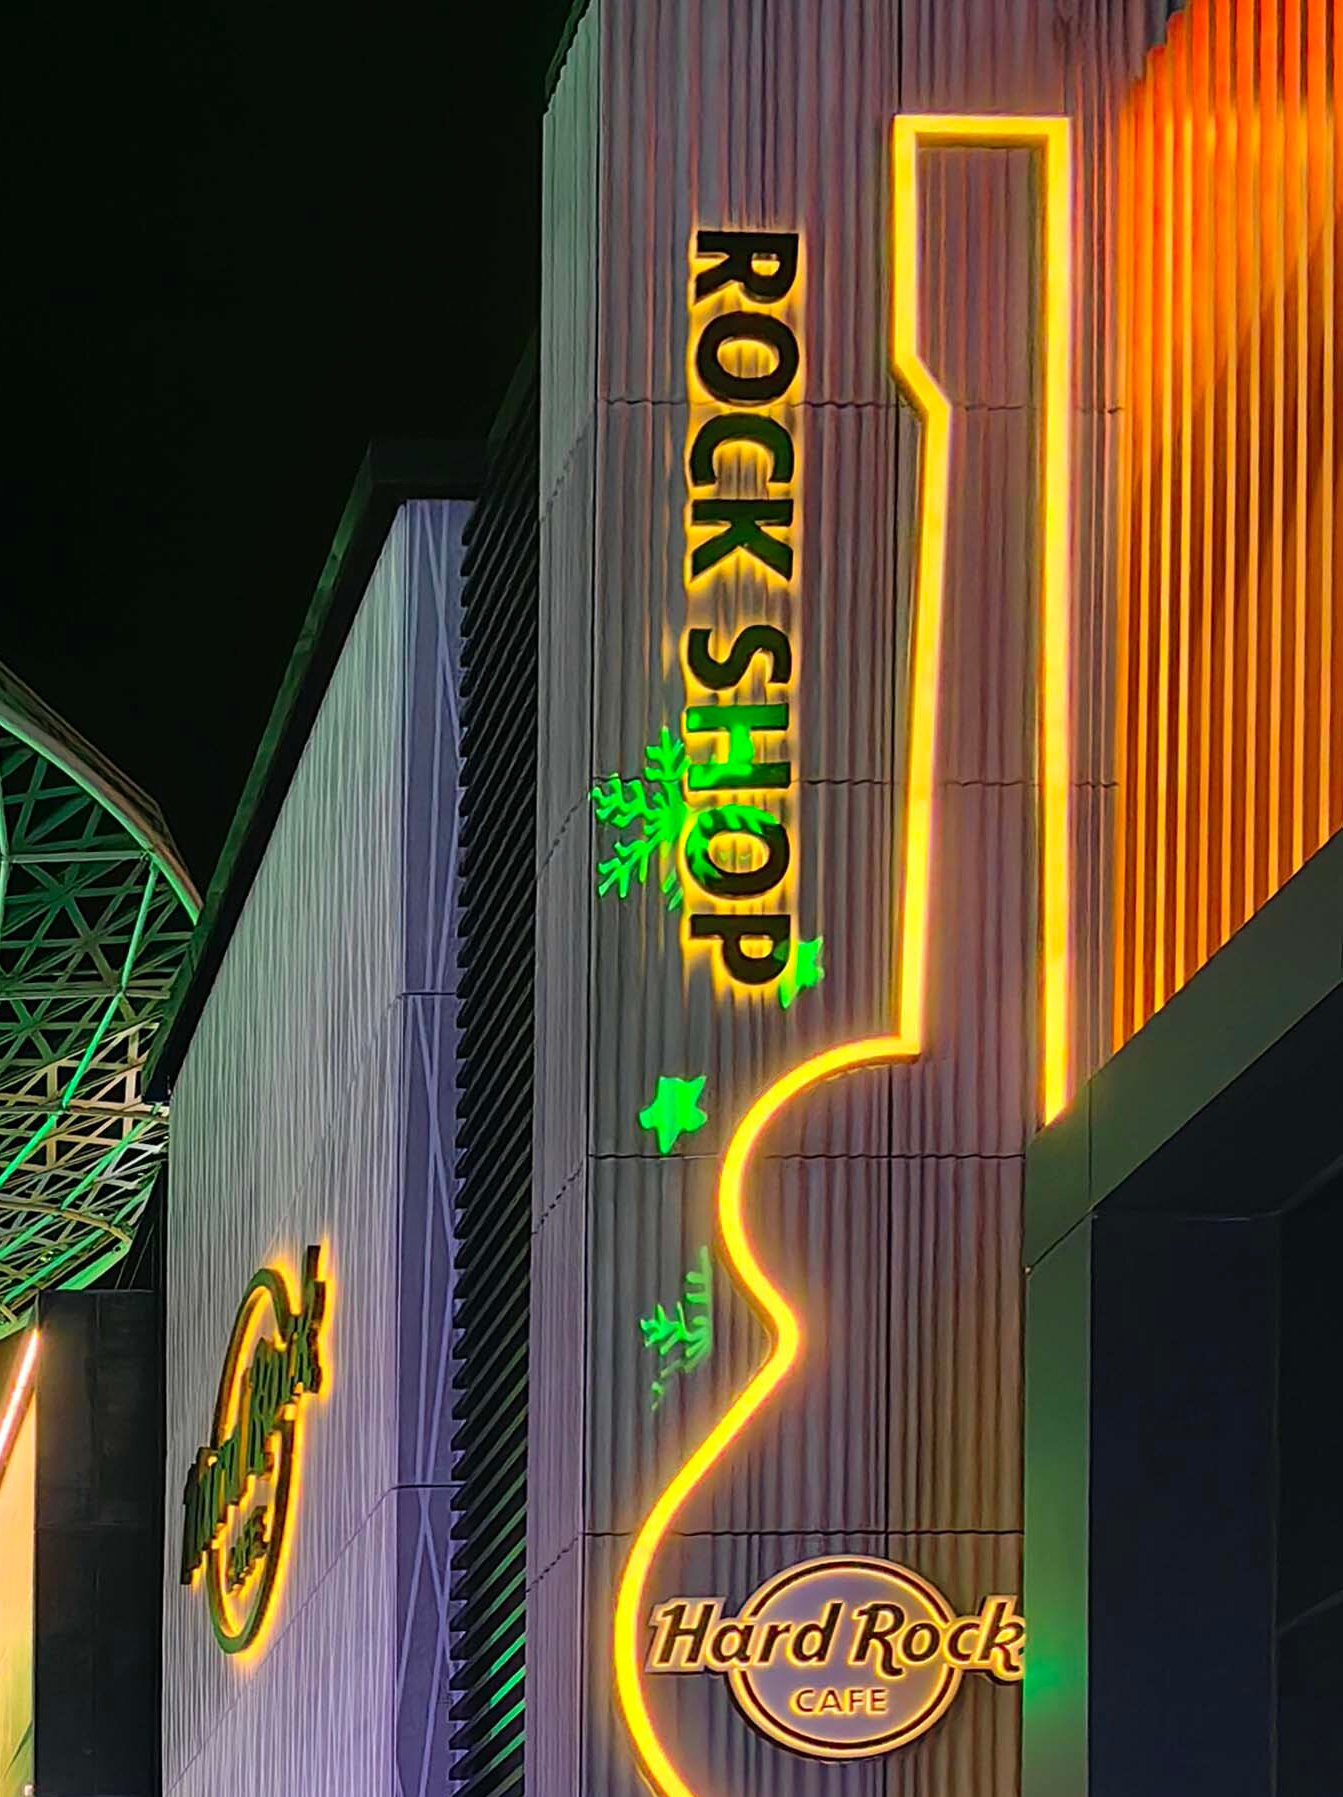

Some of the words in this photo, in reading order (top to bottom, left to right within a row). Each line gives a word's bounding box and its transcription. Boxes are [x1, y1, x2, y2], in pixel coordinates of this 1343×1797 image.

[689, 230, 800, 581] ROCK
[686, 627, 791, 987] SHOP
[656, 1601, 843, 1664] Hard
[853, 1601, 1024, 1676] Rock
[795, 1688, 888, 1713] CAFE
